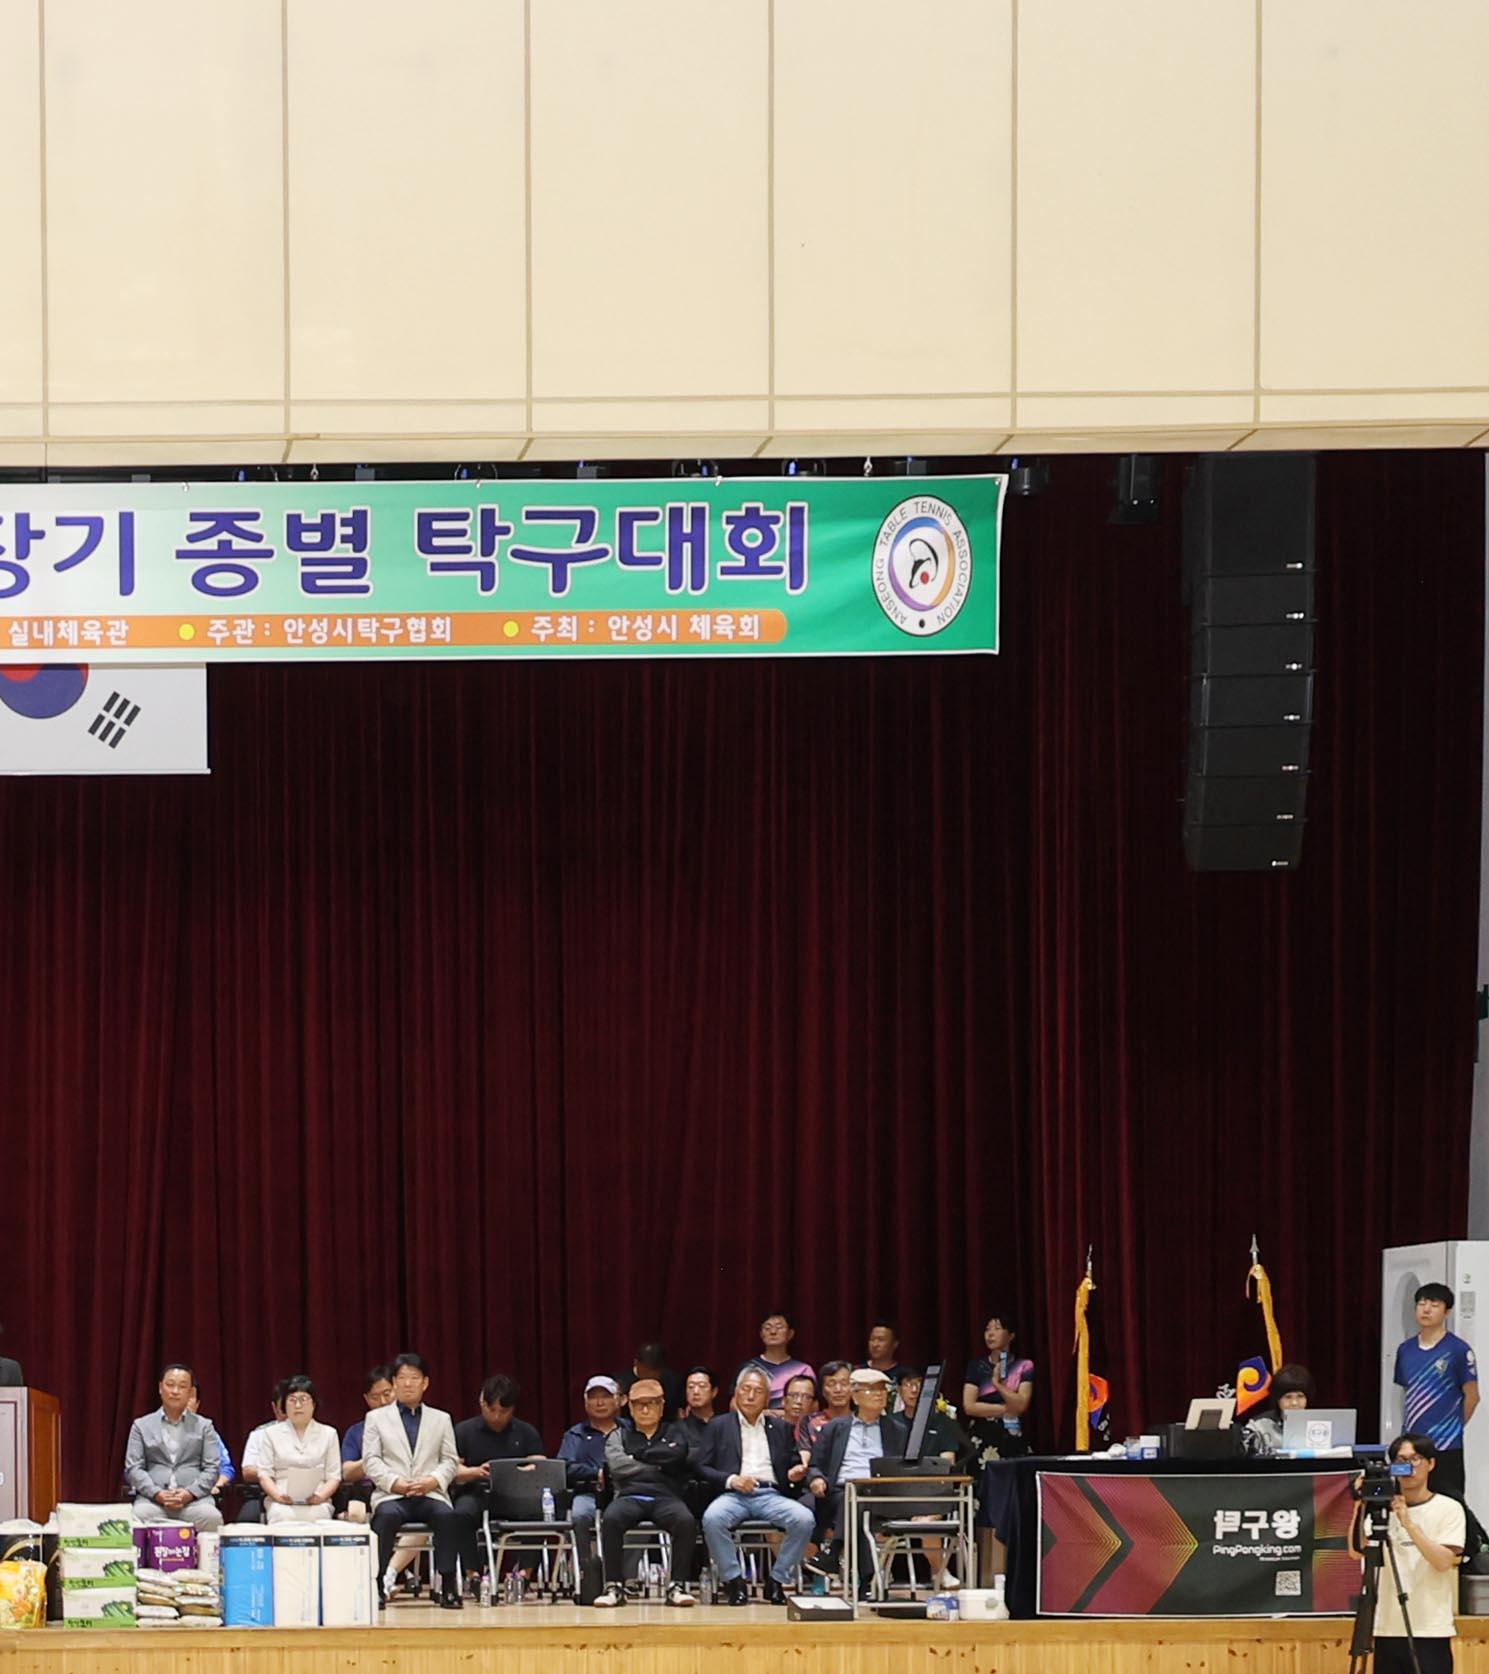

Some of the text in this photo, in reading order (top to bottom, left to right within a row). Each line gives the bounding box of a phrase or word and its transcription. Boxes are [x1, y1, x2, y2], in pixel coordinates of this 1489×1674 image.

[175, 508, 372, 598] 종별
[415, 503, 808, 598] 탁구대회
[9, 619, 129, 647] 실내체육관
[206, 616, 452, 645] 주관 안성시탁구협회
[530, 613, 761, 643] 주최 안성시 체육회
